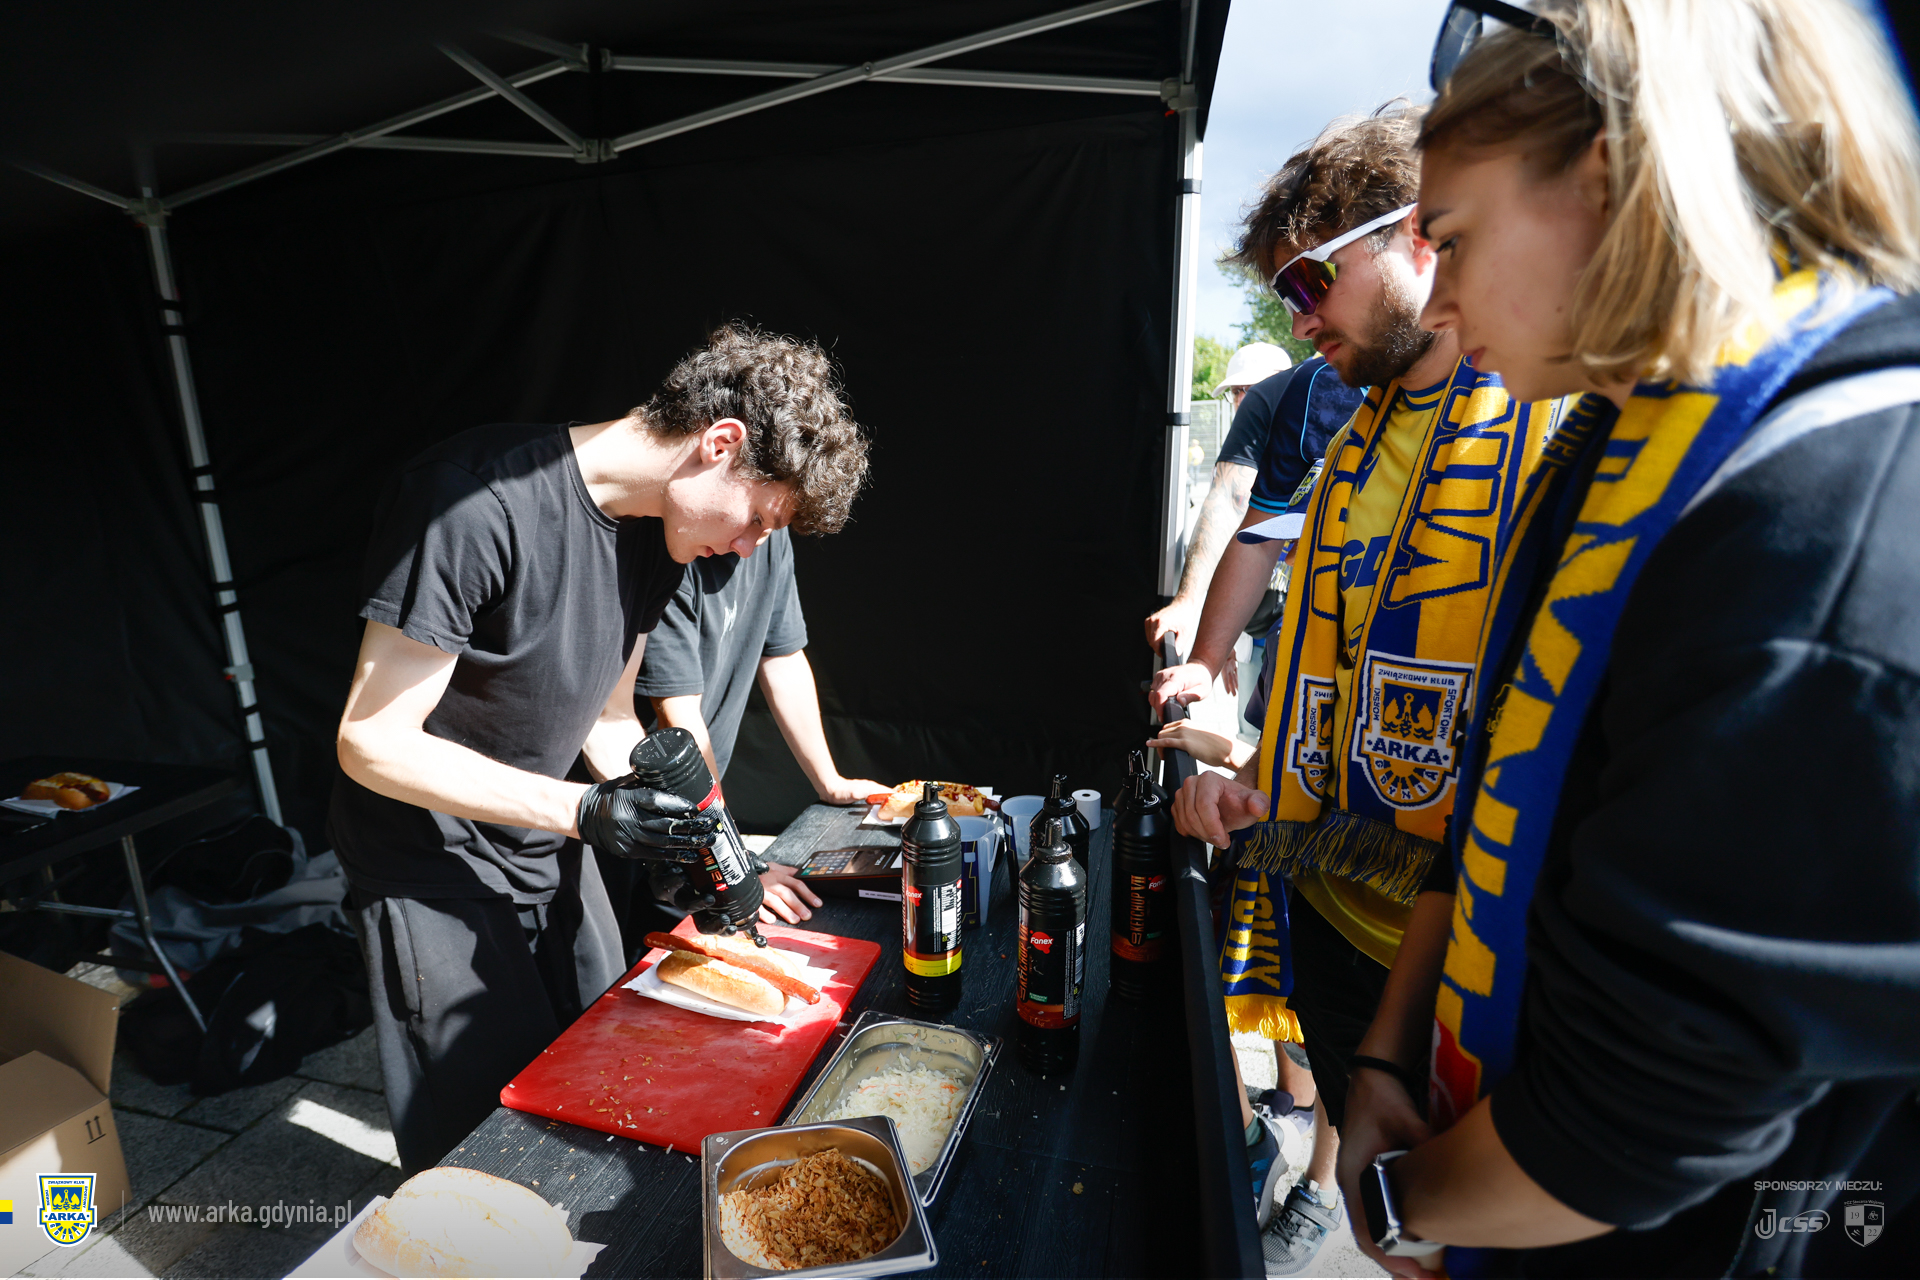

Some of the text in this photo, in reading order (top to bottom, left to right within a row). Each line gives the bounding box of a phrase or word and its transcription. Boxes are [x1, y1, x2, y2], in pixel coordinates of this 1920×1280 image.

[1377, 668, 1456, 686] ZWIĄZKOWY KLUB
[1372, 687, 1381, 721] MORSKI
[1436, 688, 1458, 740] SPORTOWY
[1309, 707, 1317, 738] MORSKI
[1372, 737, 1443, 766] ARKA
[1375, 757, 1439, 799] GDYNIA
[1130, 874, 1146, 932] KETCHUP VII
[1030, 936, 1054, 945] Fanex
